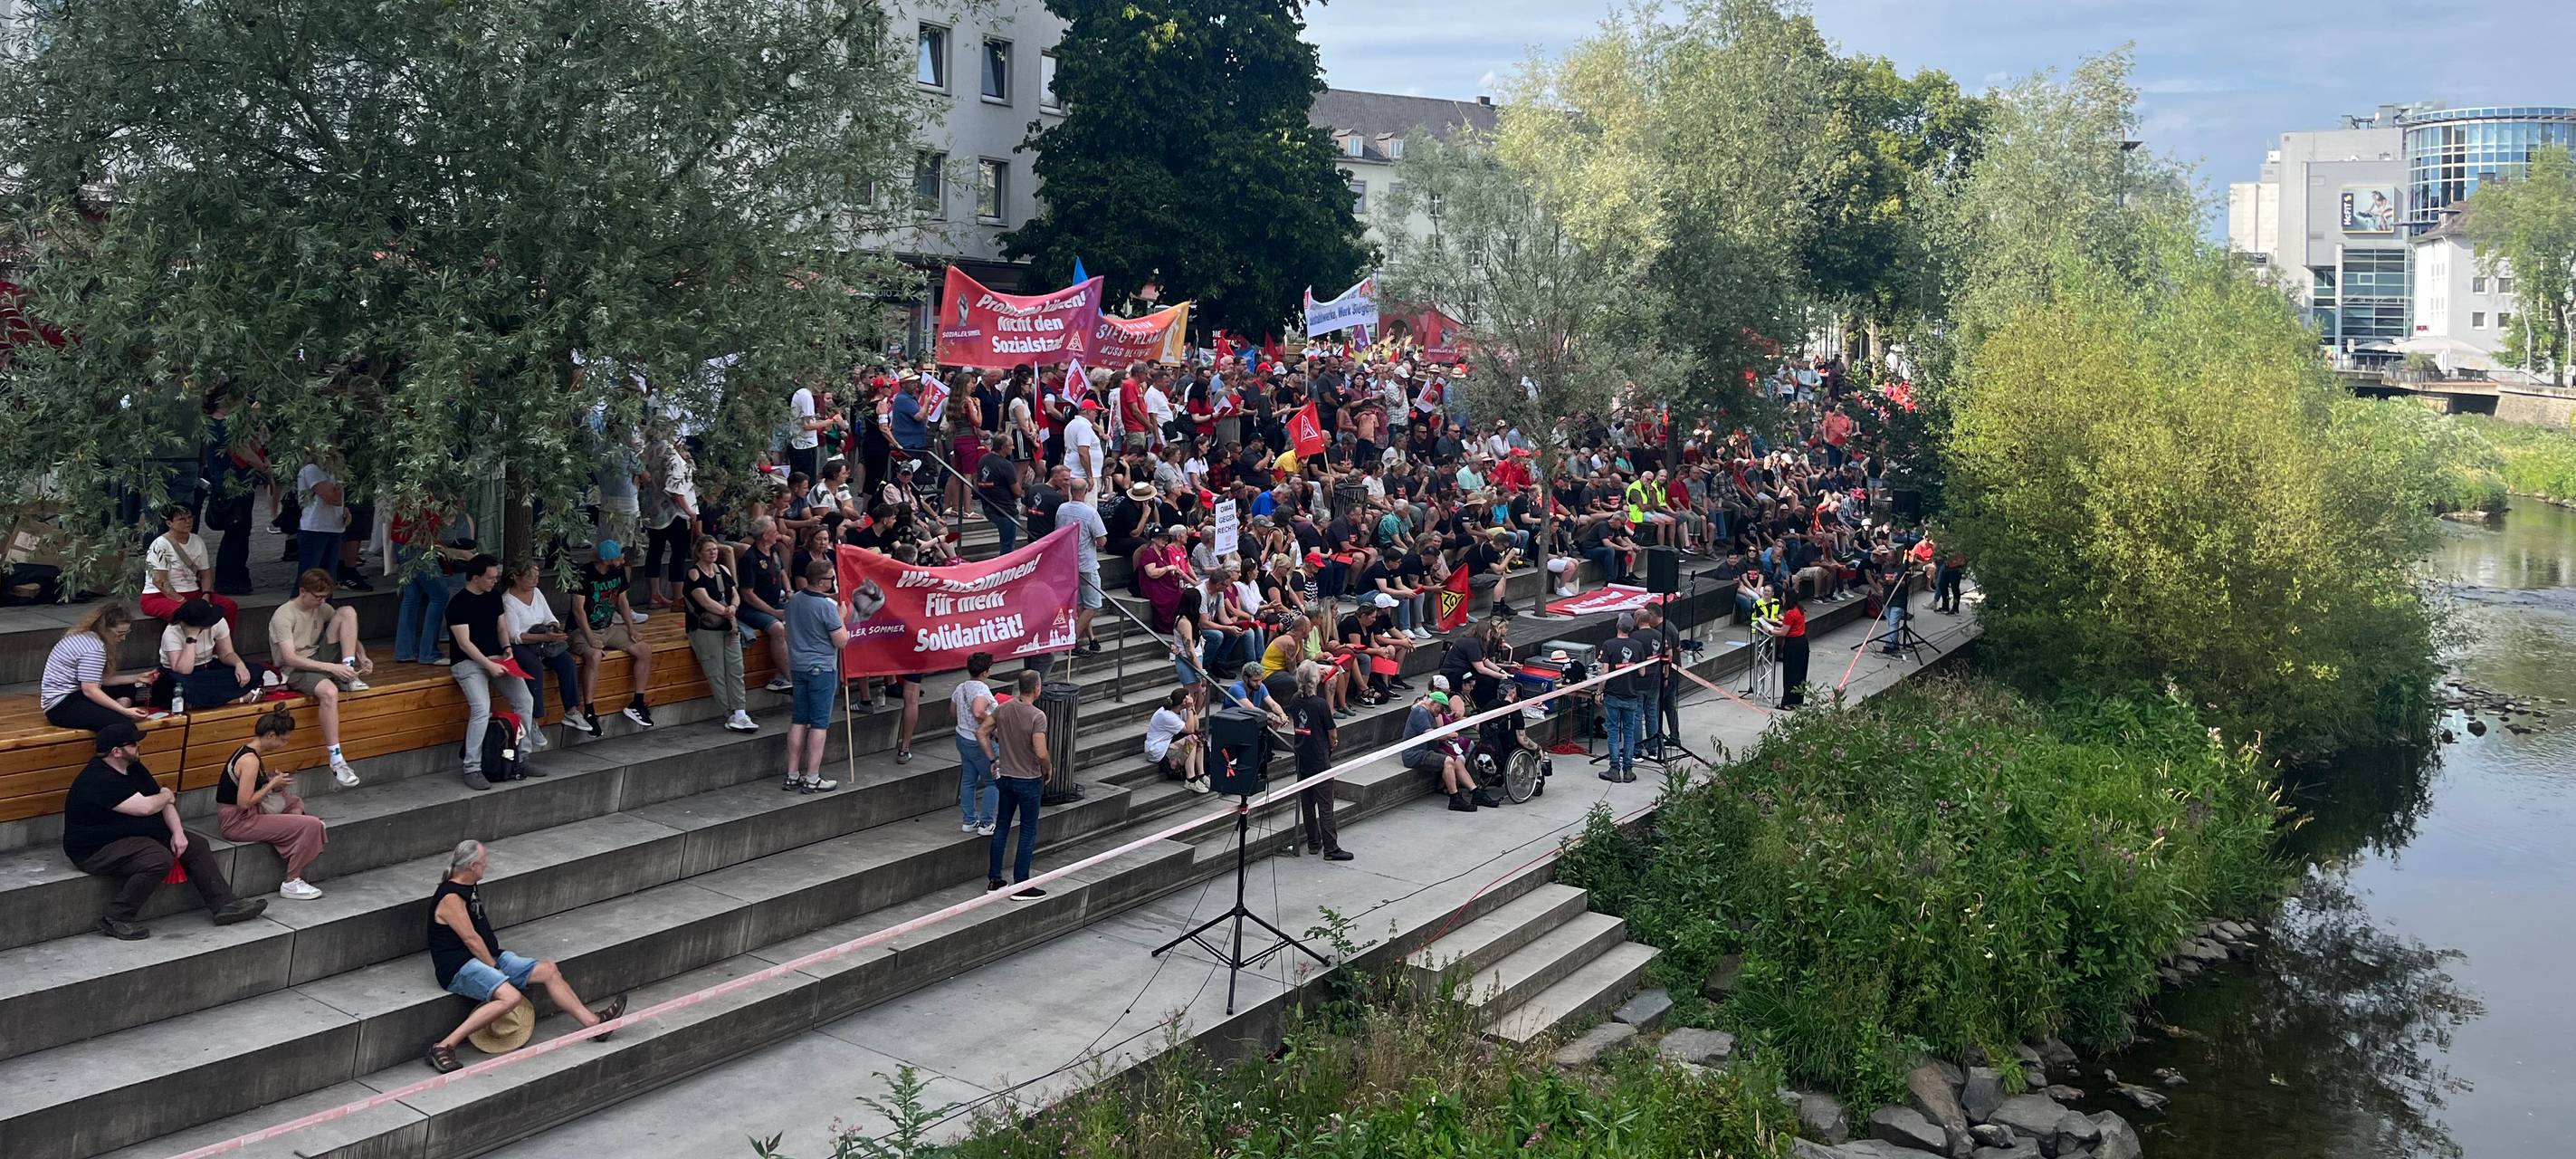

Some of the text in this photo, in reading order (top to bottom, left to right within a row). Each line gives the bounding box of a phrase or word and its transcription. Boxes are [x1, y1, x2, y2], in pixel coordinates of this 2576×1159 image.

[997, 315, 1064, 331] Nicht den
[896, 552, 1043, 593] Wir zusammen!
[925, 589, 1007, 618] Für mehr
[868, 624, 905, 635] SOMMER
[913, 613, 1026, 653] Solidarität!
